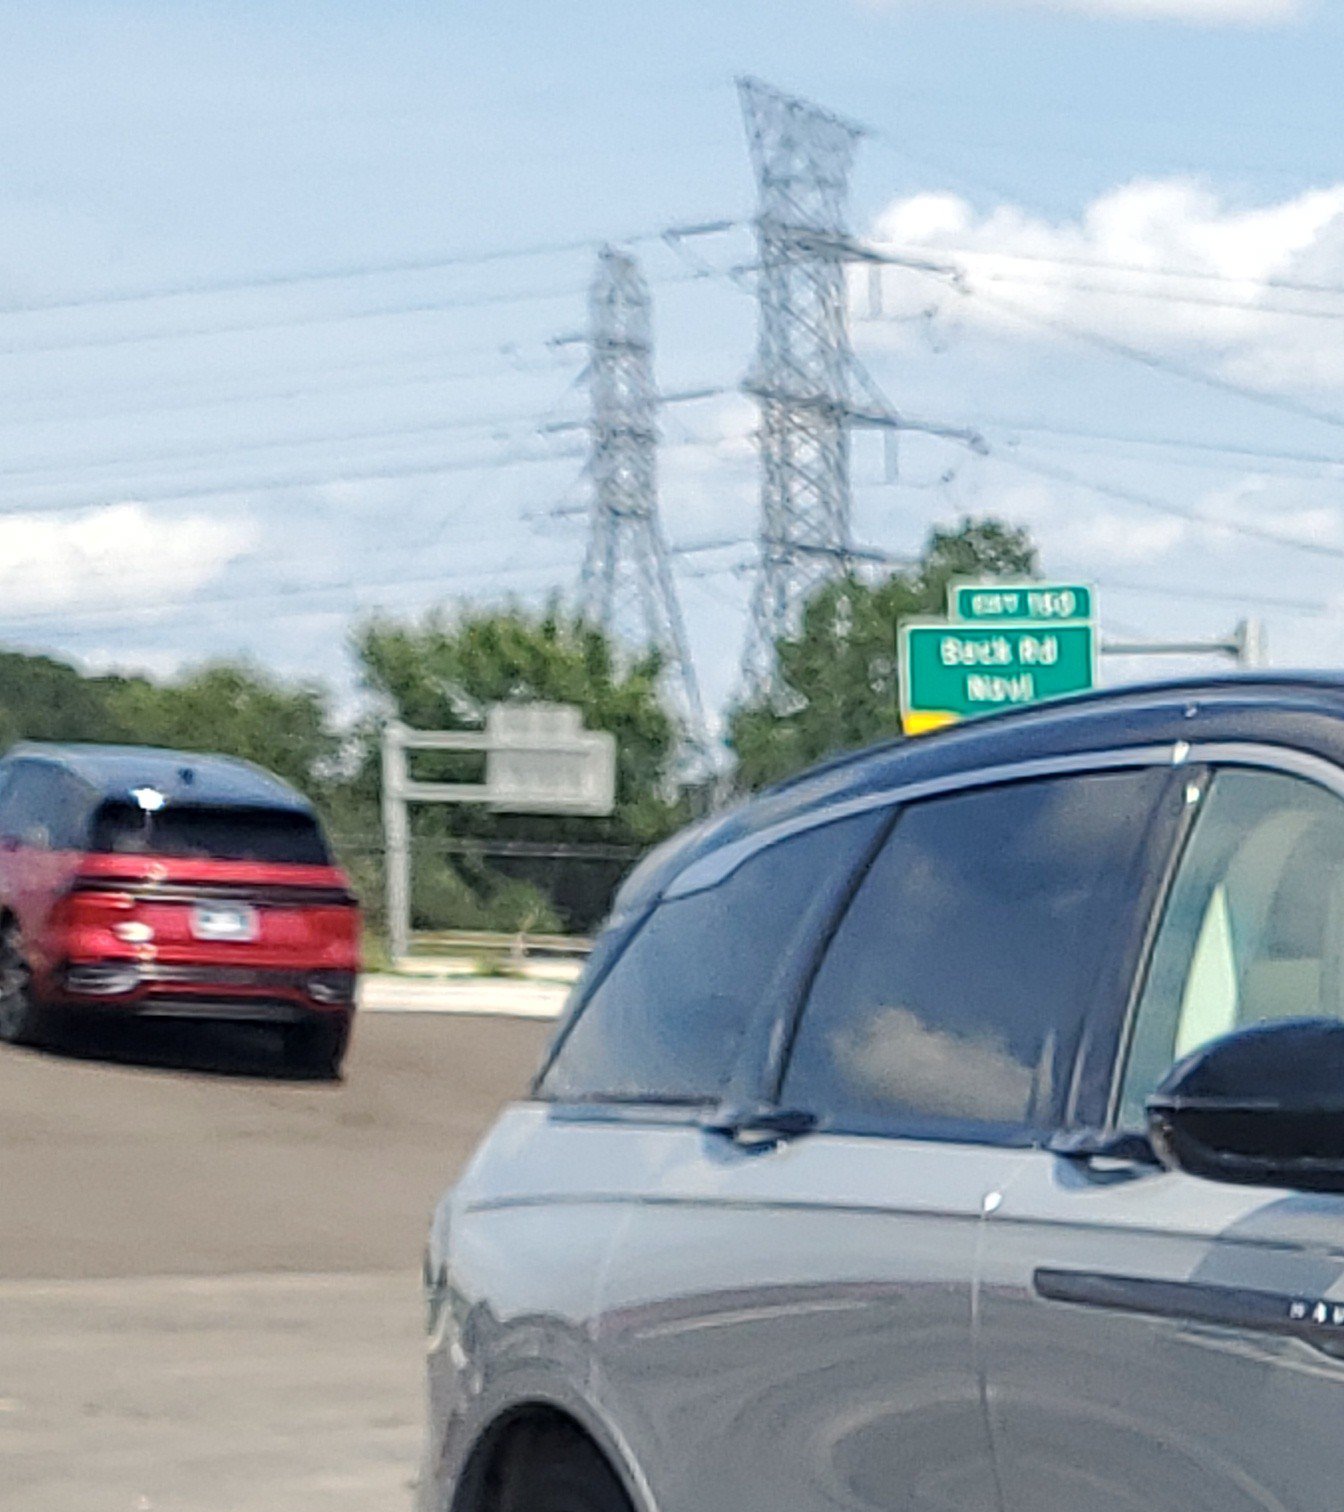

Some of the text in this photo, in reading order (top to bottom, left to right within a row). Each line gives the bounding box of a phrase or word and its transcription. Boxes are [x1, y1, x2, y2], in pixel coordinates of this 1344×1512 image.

[940, 635, 1059, 666] Beck Rd
[967, 672, 1034, 702] Novi
